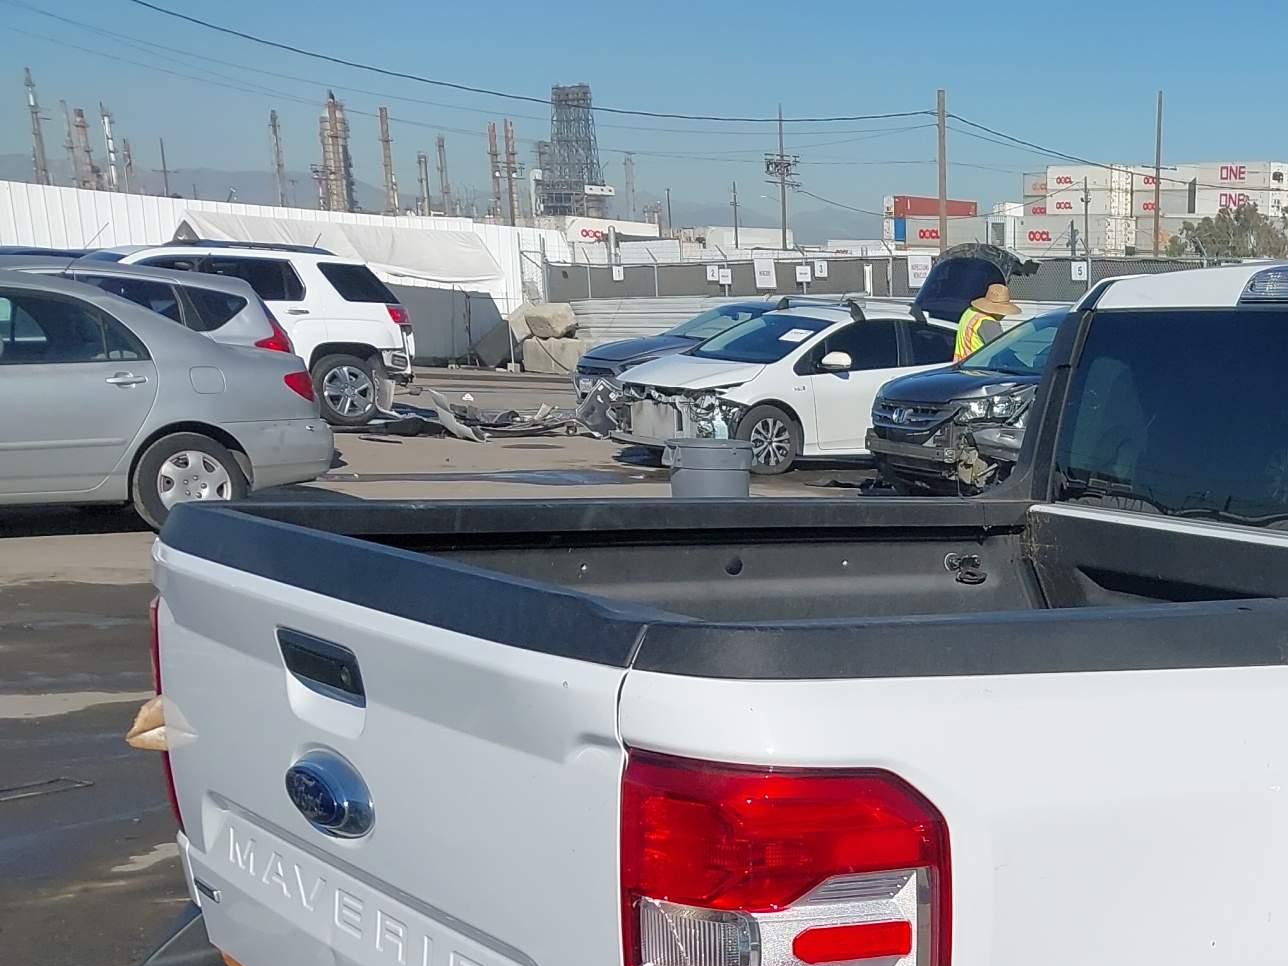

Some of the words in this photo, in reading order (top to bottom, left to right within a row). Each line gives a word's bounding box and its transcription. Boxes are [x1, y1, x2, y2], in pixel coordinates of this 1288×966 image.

[1220, 165, 1247, 181] ONE
[1028, 231, 1052, 242] OOCL
[1077, 265, 1083, 276] 5
